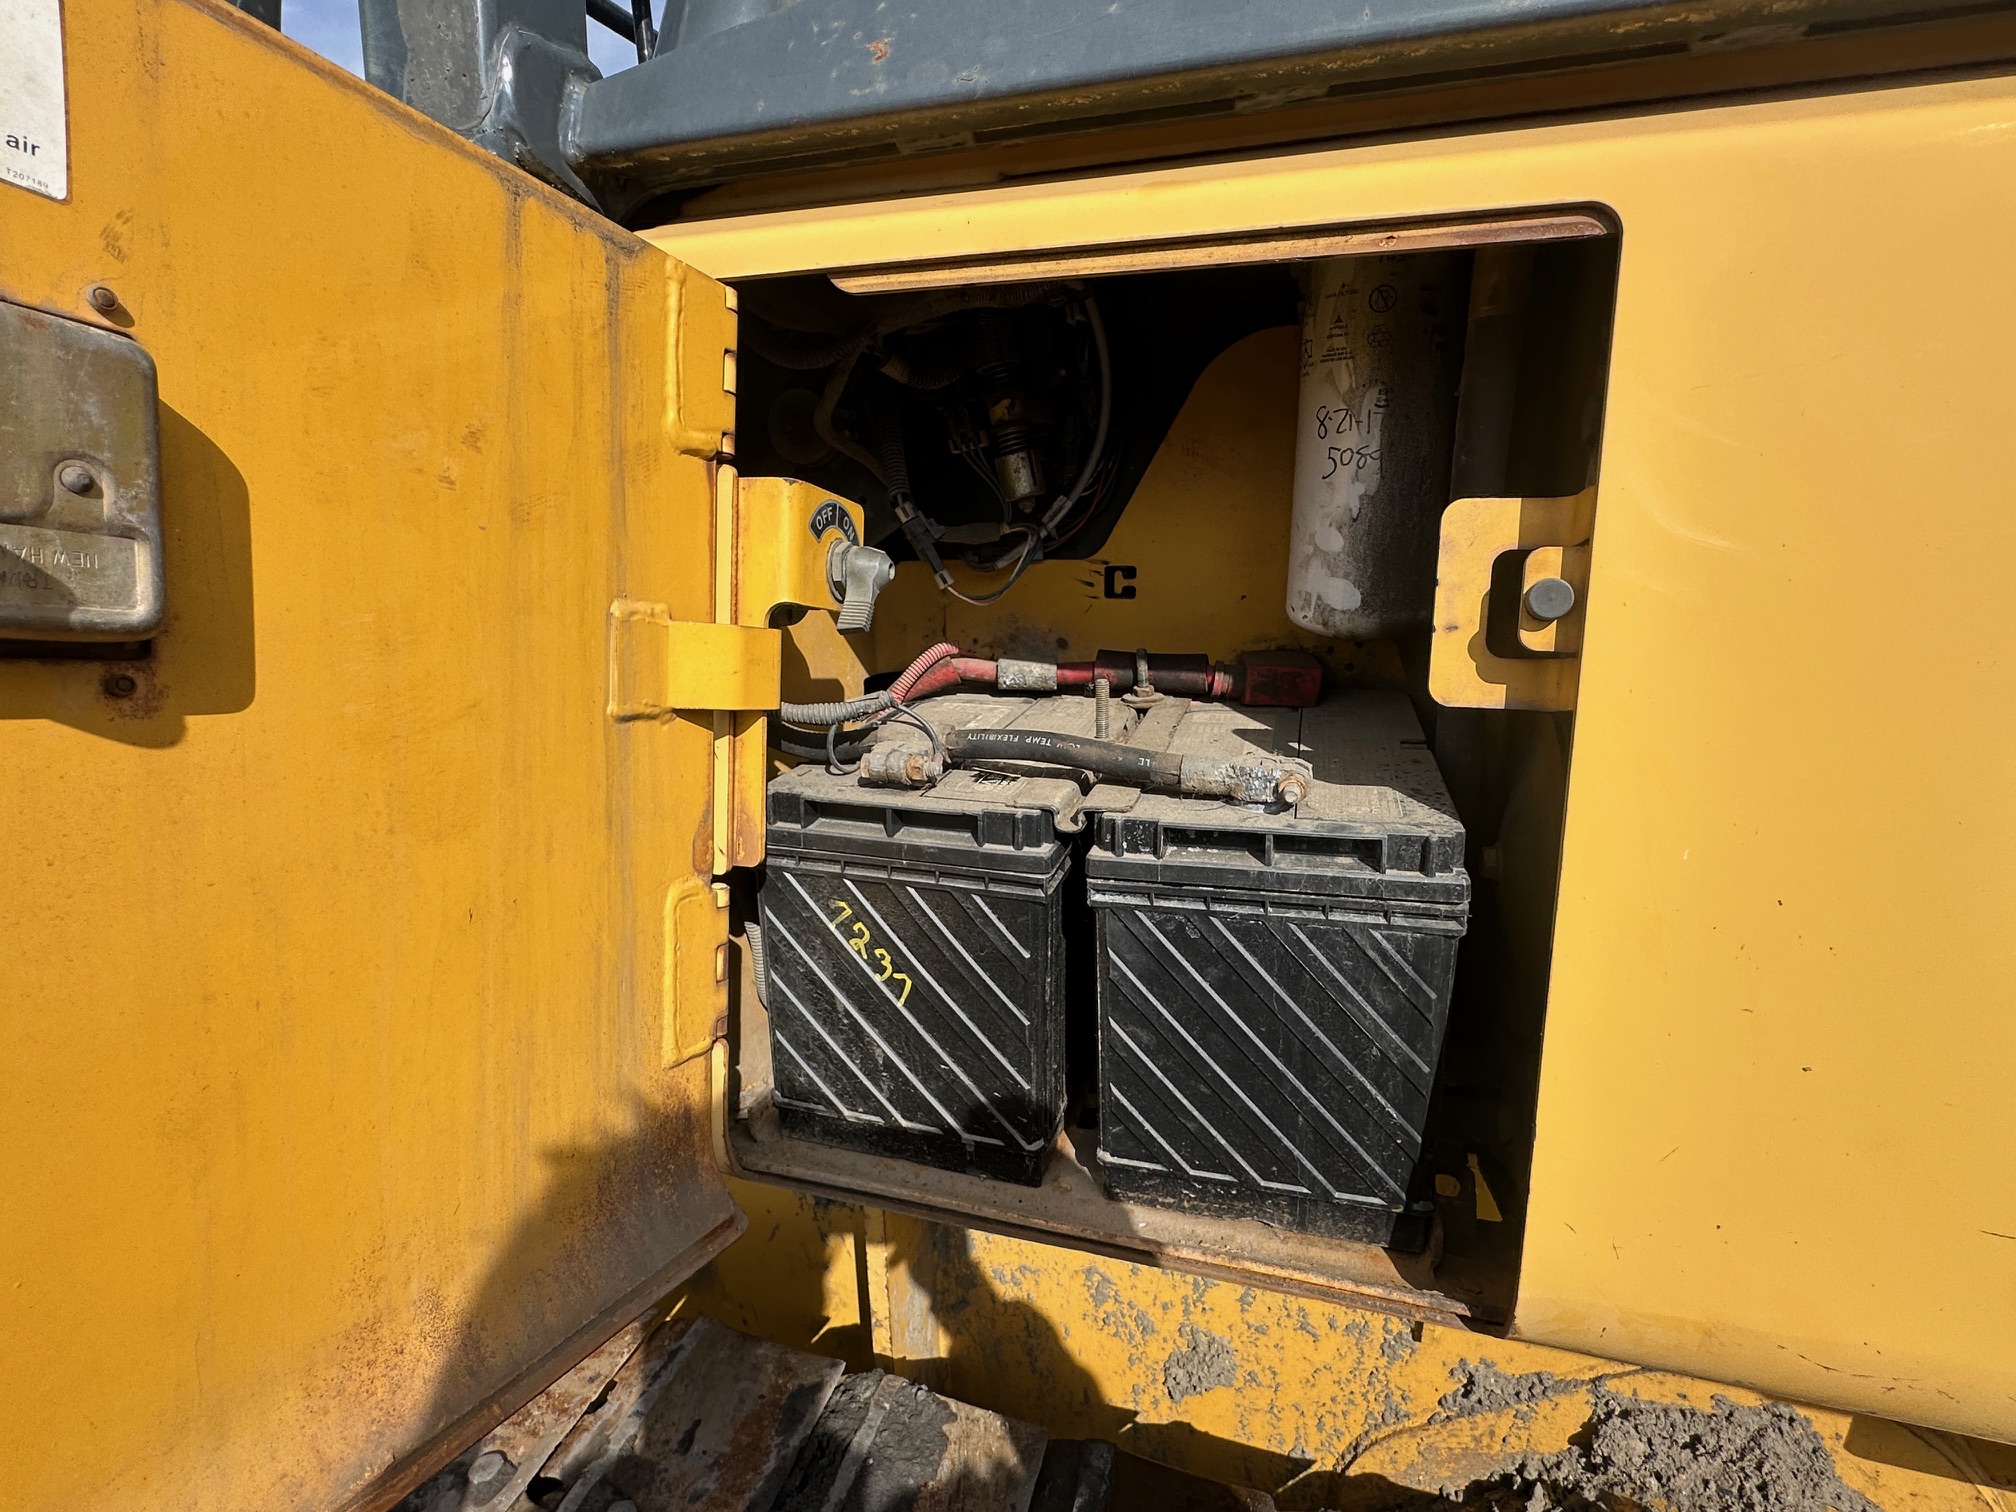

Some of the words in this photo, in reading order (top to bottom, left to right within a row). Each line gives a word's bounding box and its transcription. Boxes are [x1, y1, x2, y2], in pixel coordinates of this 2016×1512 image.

[5, 134, 41, 157] air
[815, 506, 833, 530] OFF
[843, 516, 855, 541] ON
[966, 733, 1019, 743] FLEXIBILITY
[1025, 735, 1052, 747] TEMP.
